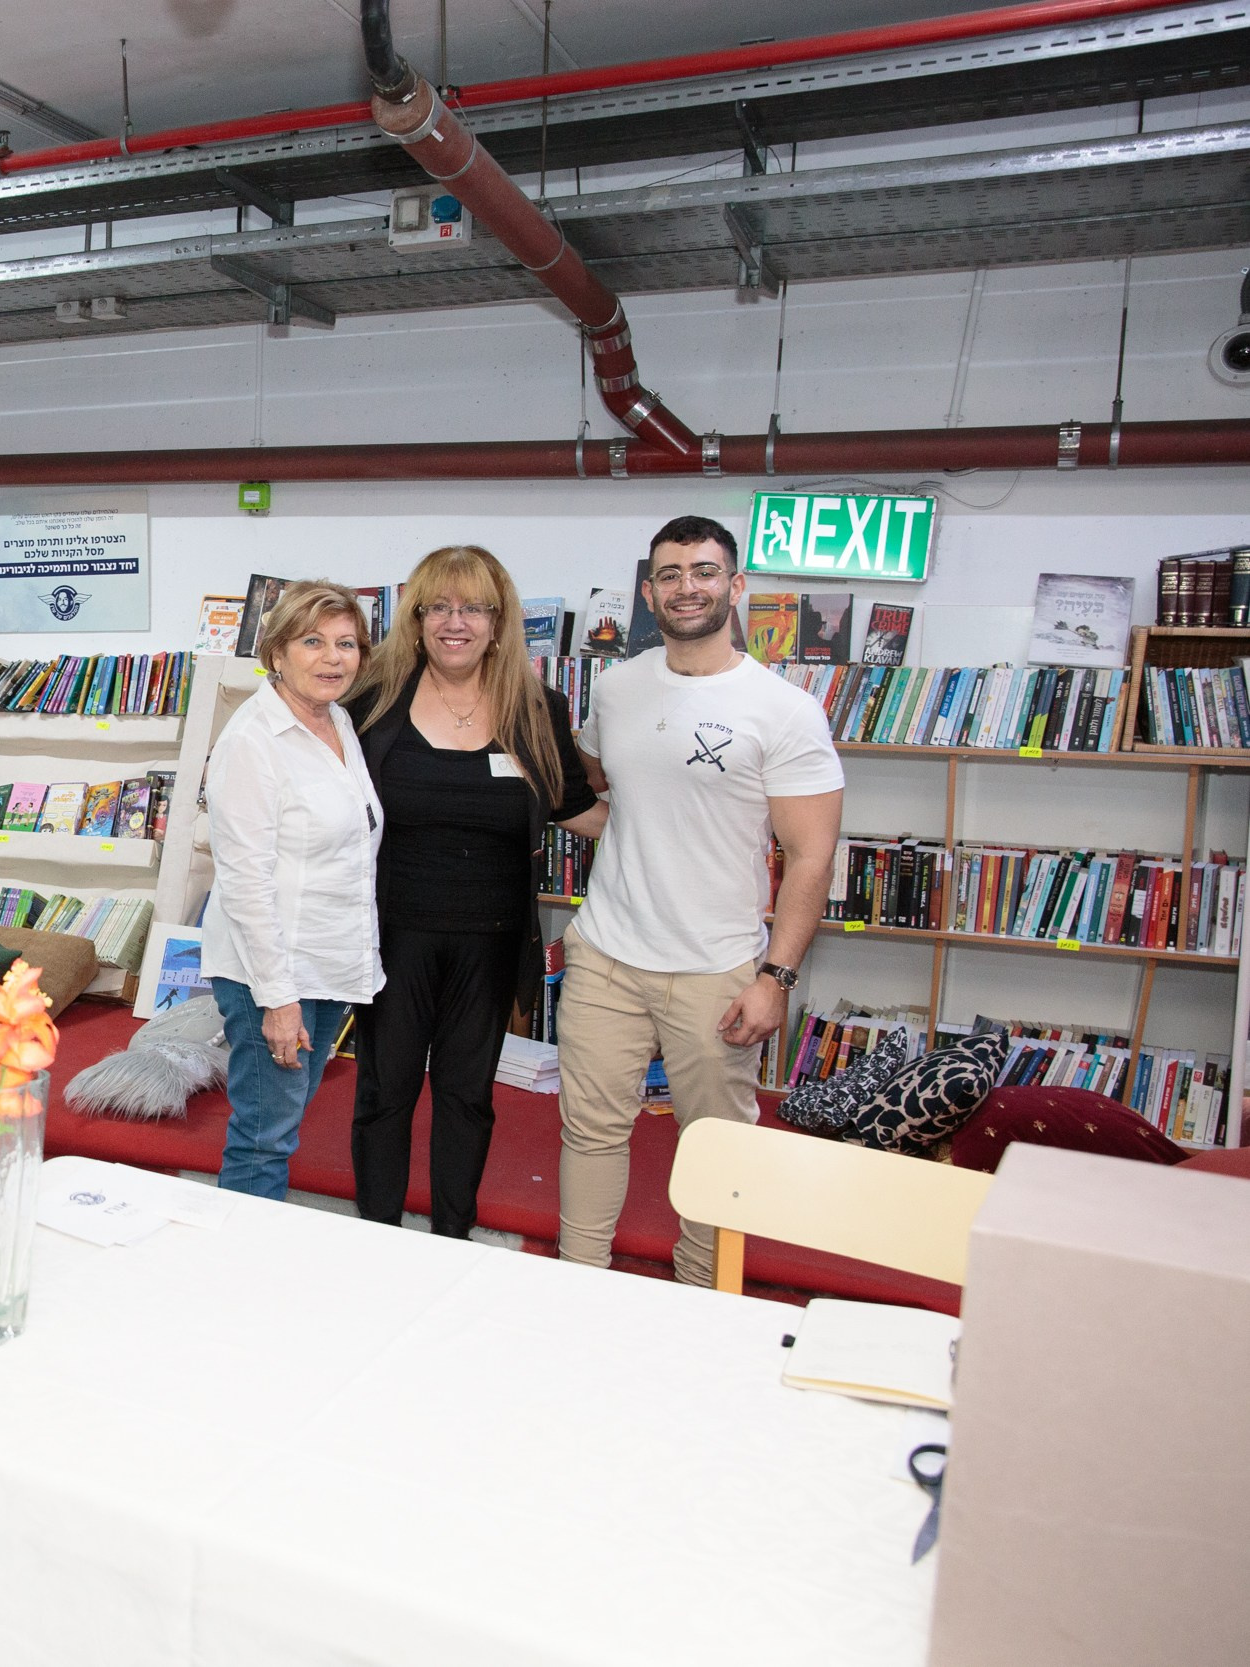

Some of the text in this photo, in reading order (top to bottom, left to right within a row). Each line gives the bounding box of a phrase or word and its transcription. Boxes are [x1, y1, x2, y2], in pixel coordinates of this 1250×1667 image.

[4, 534, 126, 548] הצטרפו אלינו ותרמו מוצרים
[803, 498, 927, 573] EXIT
[24, 546, 104, 559] מסל הקניות שלכם
[37, 564, 71, 573] ותמיכה
[73, 563, 89, 572] כוח
[91, 562, 117, 571] נצבור
[118, 561, 136, 570] יחד
[874, 608, 911, 623] TRUE
[871, 620, 910, 636] CRIME
[864, 647, 903, 658] ANDREW
[863, 655, 901, 666] KLAVAN
[1093, 698, 1103, 717] לשמור
[714, 723, 733, 735] חרבות
